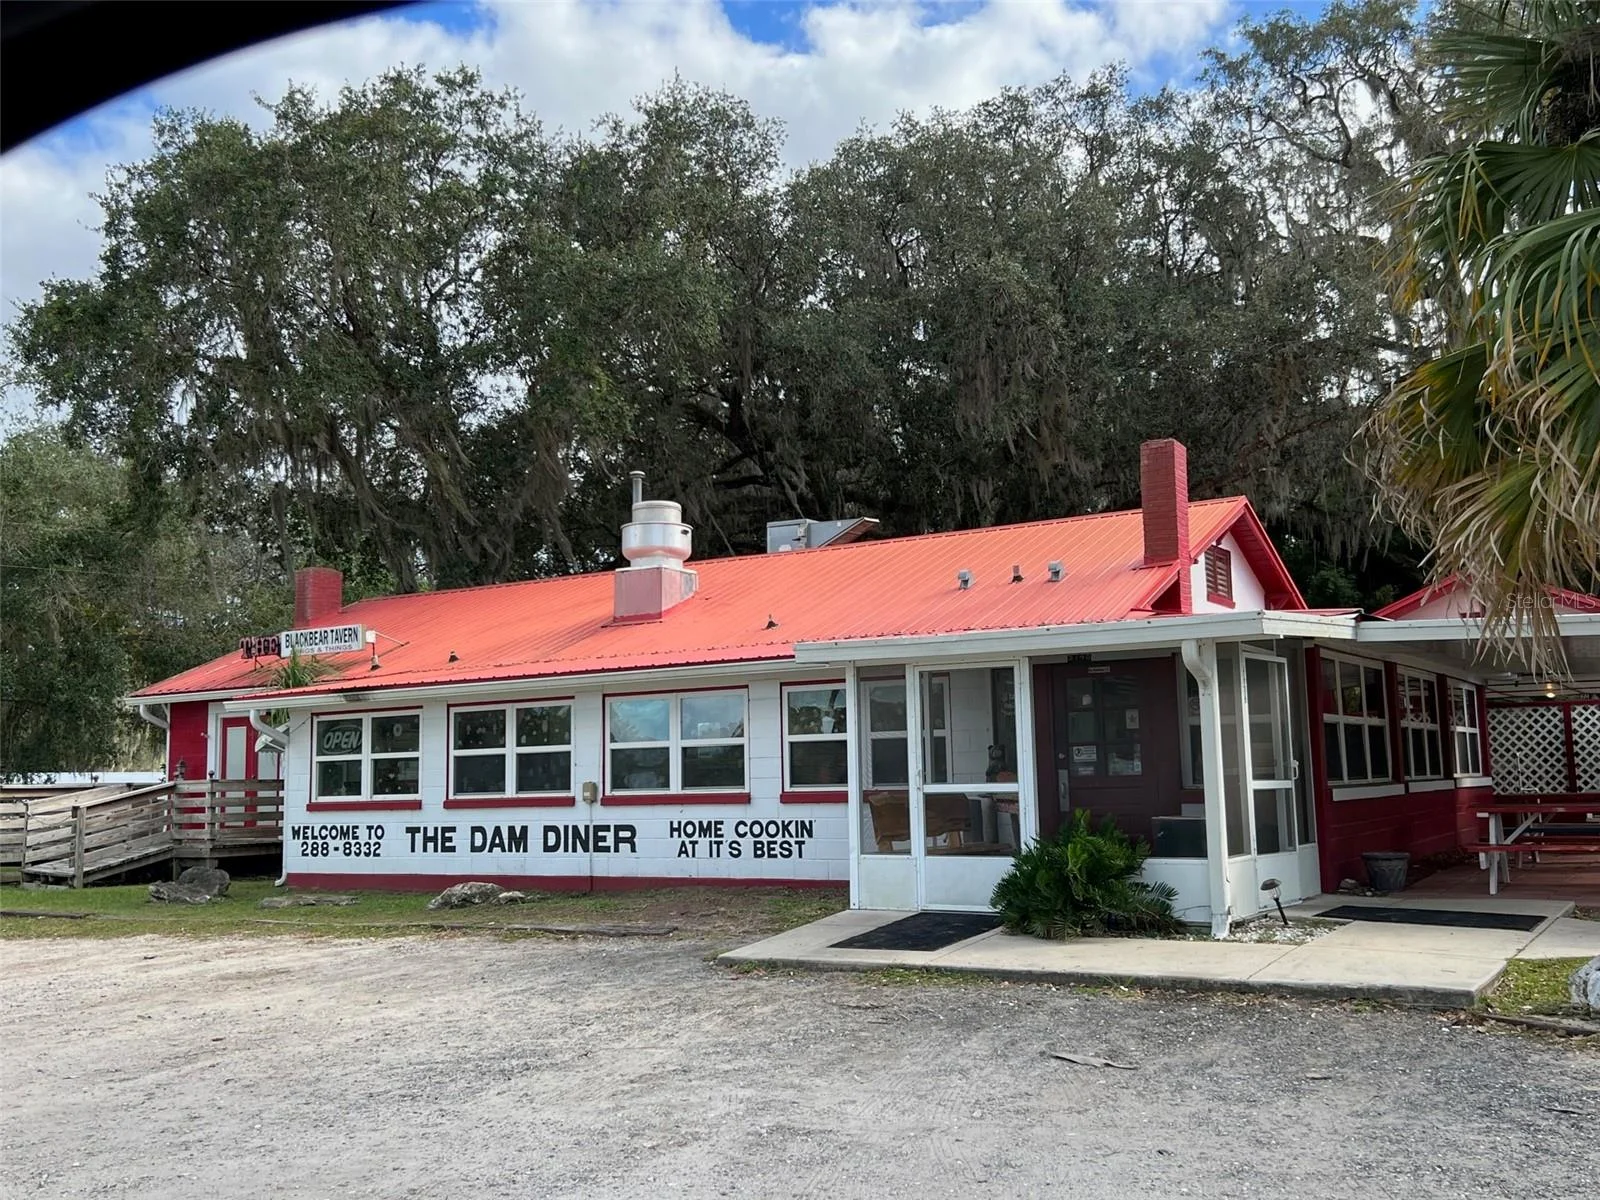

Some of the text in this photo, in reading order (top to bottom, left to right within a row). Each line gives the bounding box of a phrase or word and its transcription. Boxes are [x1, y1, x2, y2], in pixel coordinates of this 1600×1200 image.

[285, 630, 328, 649] BLACKBEAR
[330, 626, 359, 644] TAVERN
[325, 644, 353, 652] THINGS
[323, 731, 361, 749] OPEN
[291, 825, 385, 840] WELCOME TO
[405, 824, 637, 853] THE DAM DINER
[669, 819, 817, 839] HOME COOKIN'
[677, 840, 806, 859] AT IT'S BEST
